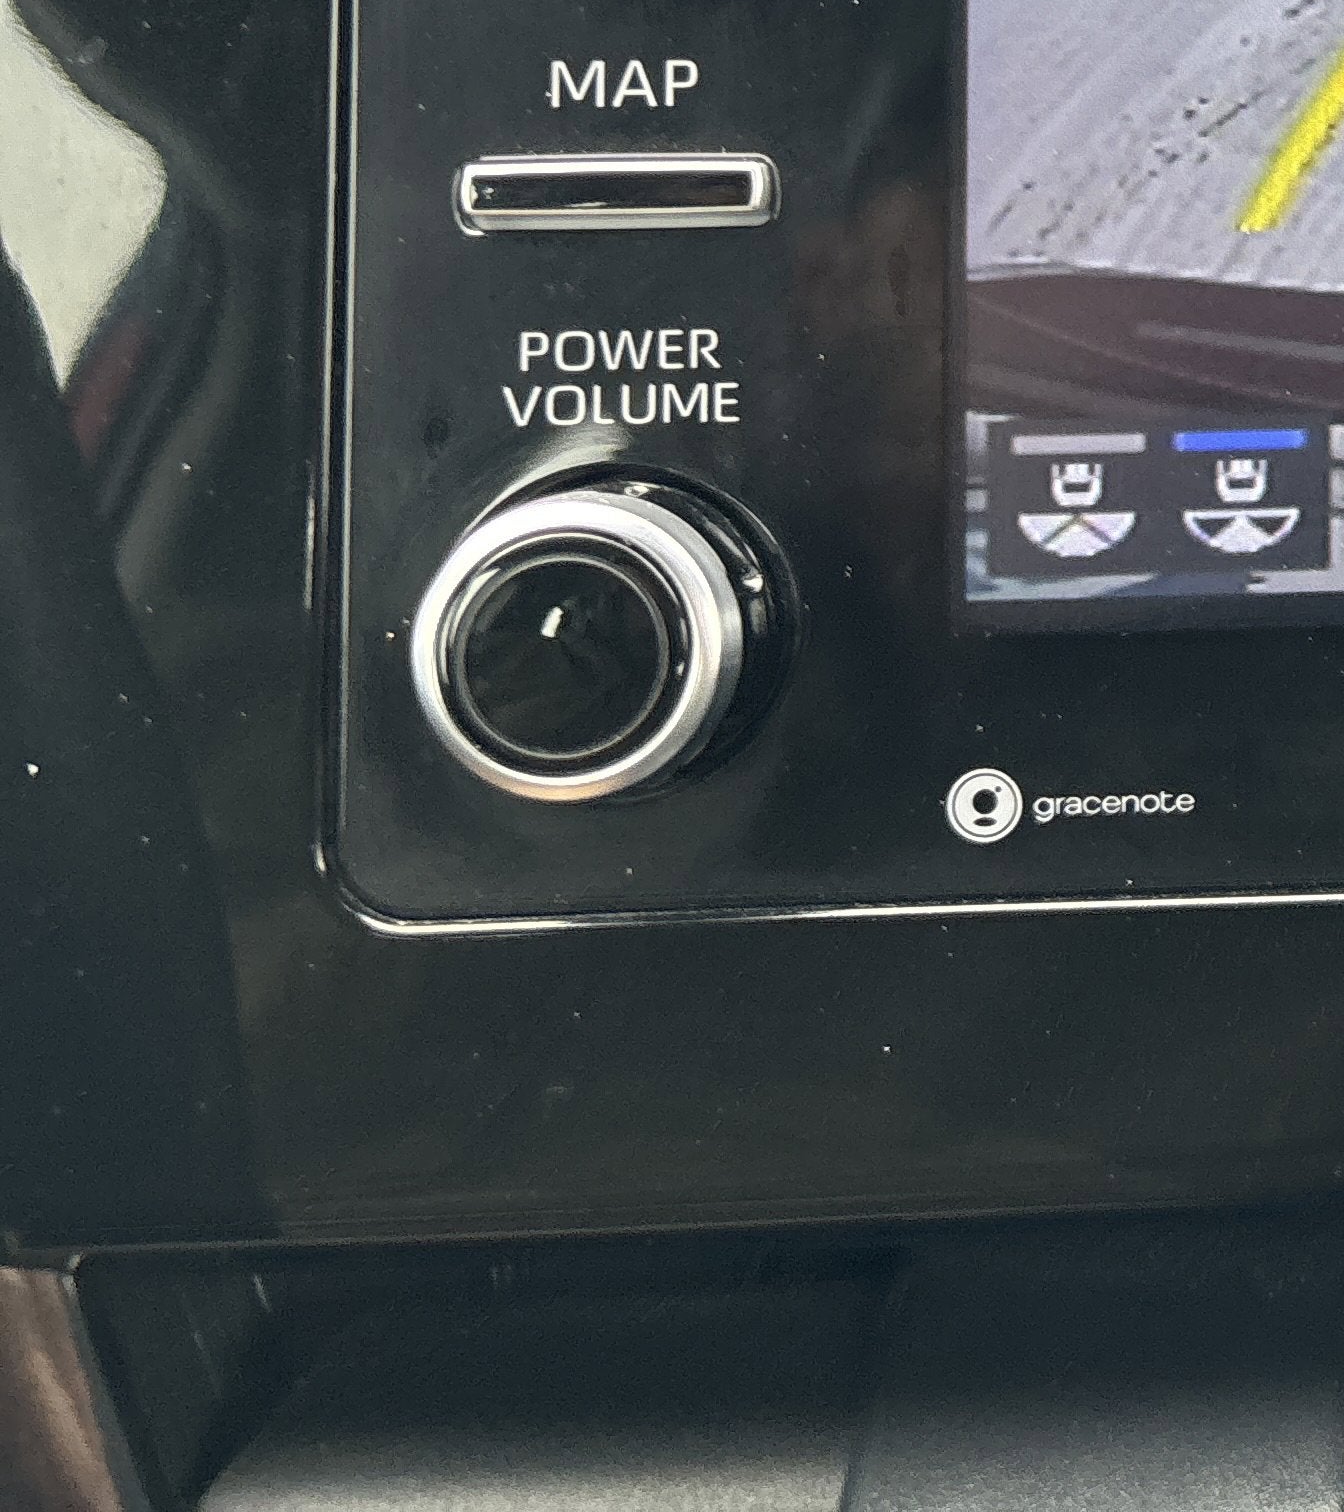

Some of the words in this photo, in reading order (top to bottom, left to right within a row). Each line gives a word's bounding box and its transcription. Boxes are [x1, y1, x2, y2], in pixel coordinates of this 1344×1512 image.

[549, 57, 700, 110] MAP
[518, 326, 722, 373] POWER
[502, 381, 742, 428] VOLUME
[1031, 789, 1197, 825] gracenote
